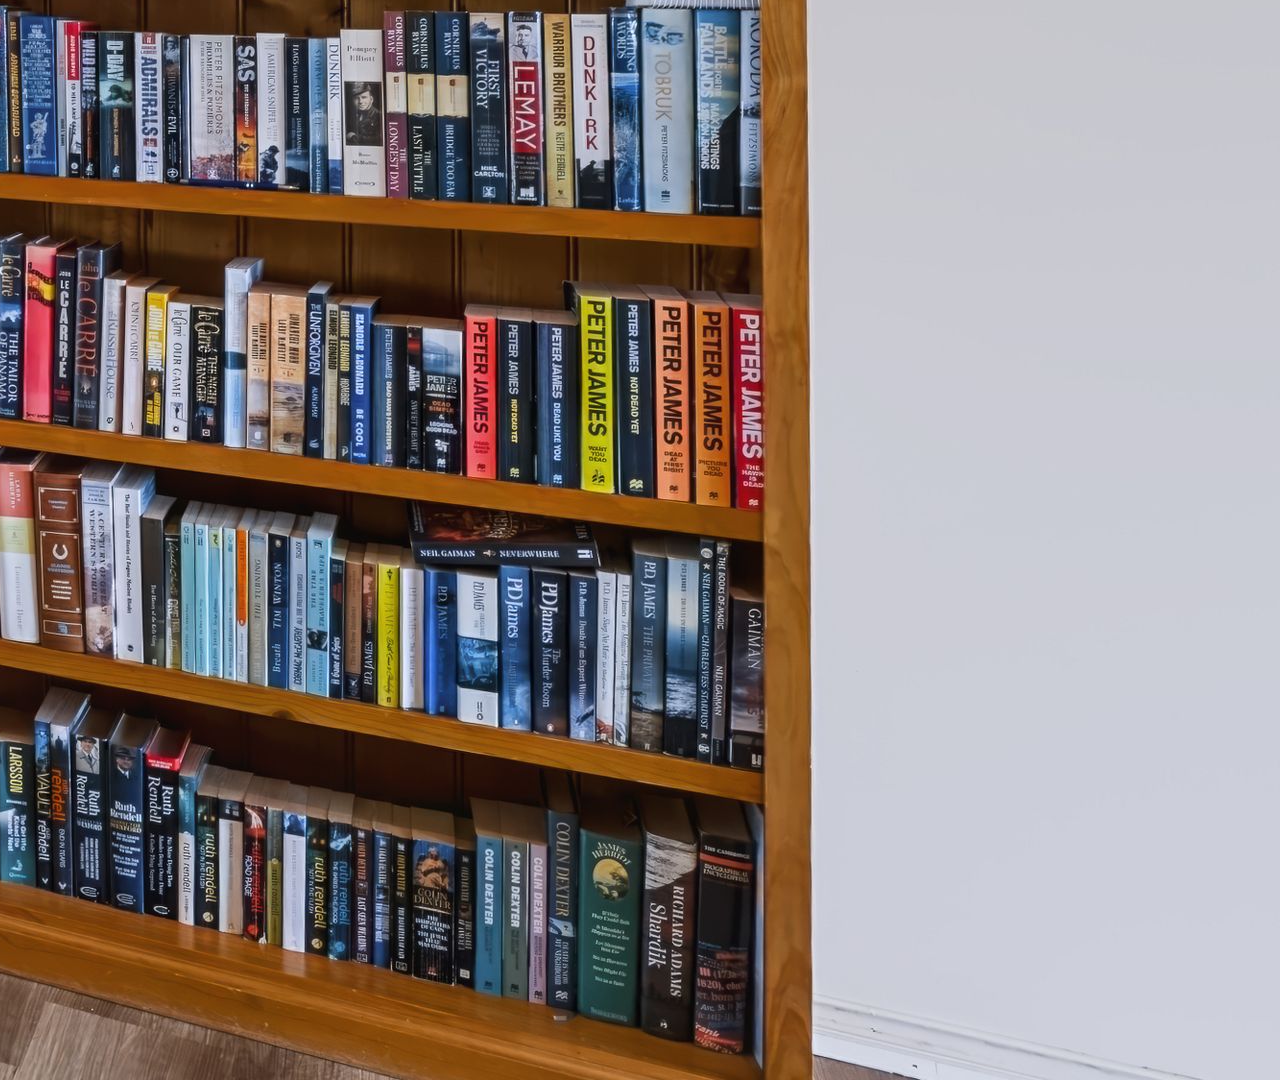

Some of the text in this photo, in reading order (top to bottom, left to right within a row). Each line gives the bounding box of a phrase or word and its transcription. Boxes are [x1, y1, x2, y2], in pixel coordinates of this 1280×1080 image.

[106, 40, 124, 81] D-DAY
[236, 45, 255, 82] SAS
[387, 30, 395, 53] RYAN
[395, 17, 403, 67] CORNELIUS
[419, 18, 428, 69] CORNELIUS
[452, 19, 460, 70] CORNELIUS
[700, 23, 713, 98] FALKLANDS
[714, 26, 728, 71] BATTLE
[142, 57, 158, 136] ADMIRALS
[215, 42, 223, 135] PETER FITZSIMONS
[329, 44, 340, 100] DUNKIRK
[476, 49, 488, 109] VICTORY
[488, 60, 500, 98] FIRST
[552, 22, 566, 128] WARRIOR BROTHERS
[583, 36, 598, 151] DUNKIRK
[655, 52, 672, 121] TOBRUK
[514, 66, 537, 150] LEMAY
[389, 122, 399, 192] LONGEST DAY
[712, 126, 720, 170] HASTINGS
[749, 123, 757, 184] FITZSIMONS
[8, 332, 19, 403] THE TAILOR
[171, 343, 182, 399] OUR GAME
[309, 311, 321, 376] UNFORGIVEN
[473, 321, 488, 372] PETER
[509, 324, 519, 395] PETER JAMES
[552, 328, 561, 361] PETER
[587, 300, 607, 437] PETER JAMES
[628, 304, 639, 435] PETER JAMES NOT YET
[355, 313, 364, 447] ELMORE LEONARD BE COOL
[552, 363, 562, 399] JAMES
[662, 306, 682, 446] PETER JAMES
[702, 311, 722, 452] PETER JAMES
[739, 314, 763, 460] PETER JAMES
[473, 377, 489, 434] JAMES
[420, 549, 560, 557] NEIL GAIMAN NEVERWHERE
[272, 563, 282, 673] Breath TIM WINTON
[641, 582, 656, 619] JAMES
[364, 642, 373, 669] JAMES
[748, 608, 762, 670] GAIMAN
[542, 682, 552, 707] Room
[700, 689, 708, 729] STARDUST
[9, 746, 22, 794] LARSSON
[52, 768, 66, 822] rendell
[76, 775, 88, 814] Rendell
[89, 790, 100, 816] Ruth
[110, 809, 142, 822] Rendell
[115, 801, 136, 812] Ruth
[148, 776, 161, 824] Rendell
[162, 785, 174, 815] Ruth
[38, 820, 50, 861] rendell
[205, 833, 216, 903] ruth rendell
[484, 848, 494, 882] COLIN
[183, 863, 191, 893] rendell
[314, 857, 326, 929] ruth rendell
[510, 851, 521, 928] COLIN DEXTER
[533, 857, 543, 934] COLIN DEXTER
[556, 822, 571, 918] COLIN DEXTER
[484, 884, 494, 926] DEXTER
[648, 902, 667, 969] Shardik
[670, 886, 684, 998] RICHARD ADAMS
